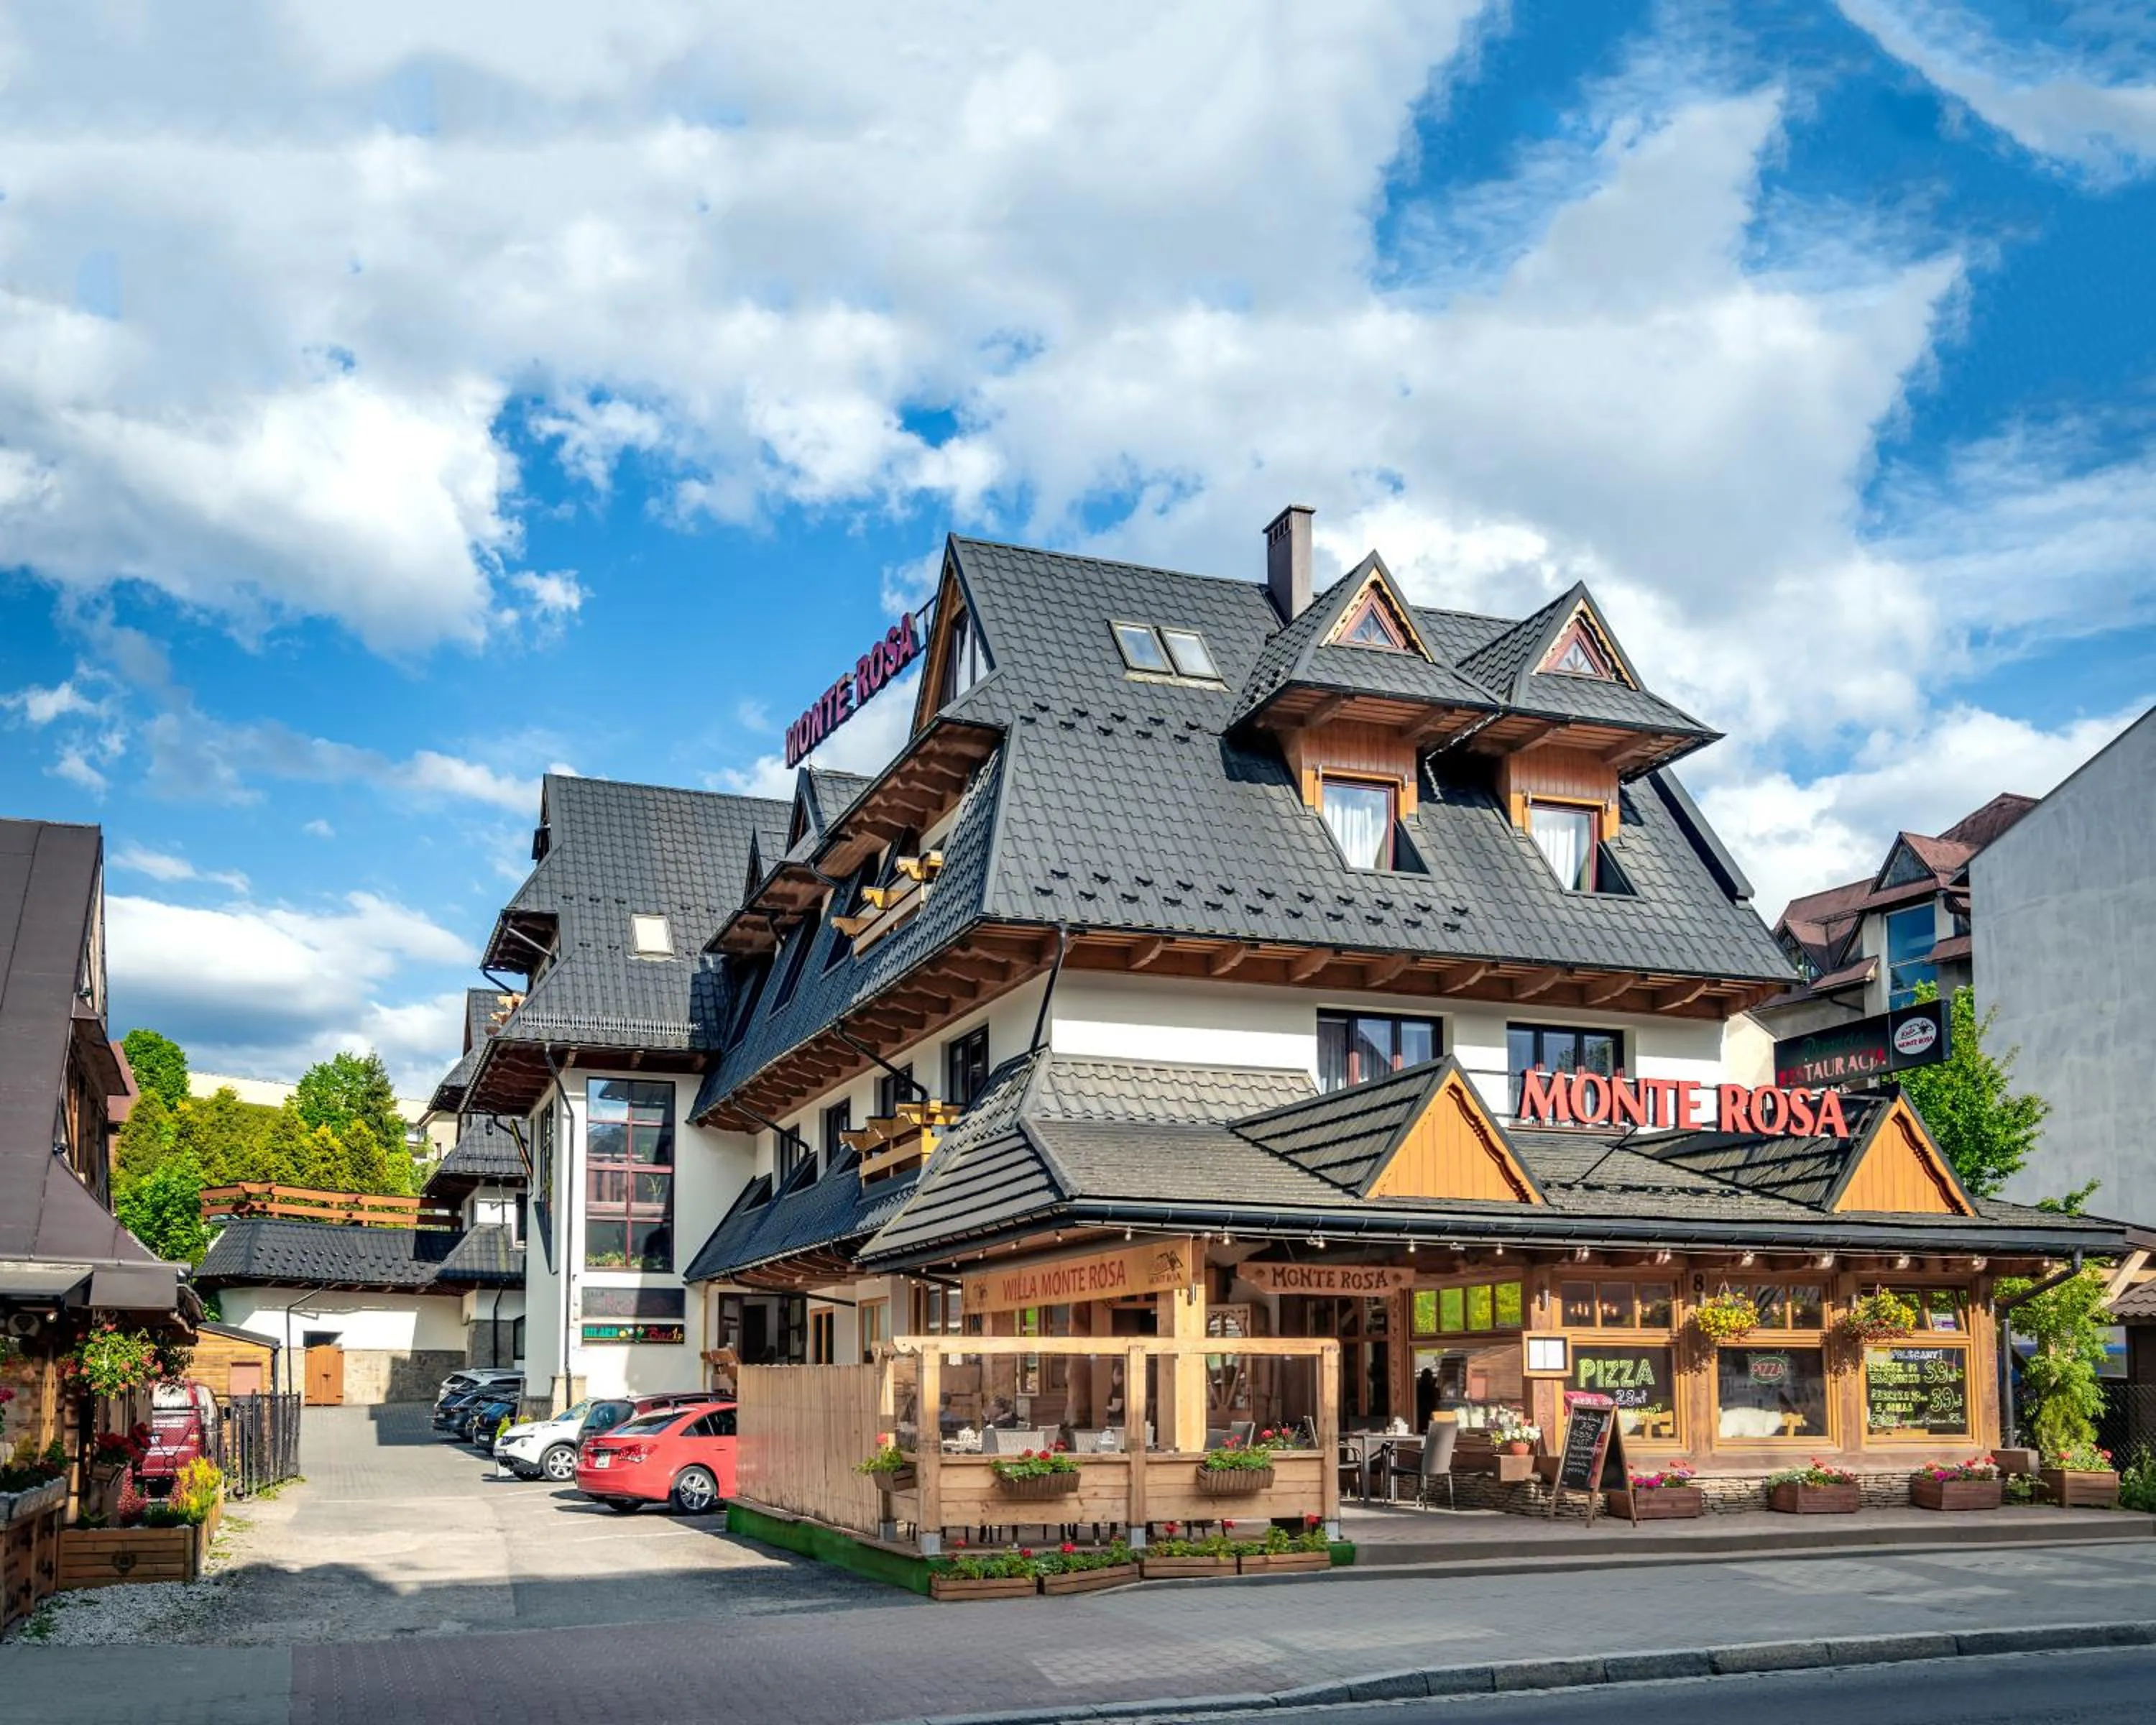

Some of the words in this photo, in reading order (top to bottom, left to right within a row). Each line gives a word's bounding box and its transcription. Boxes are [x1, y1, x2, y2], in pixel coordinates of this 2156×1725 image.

[786, 673, 852, 767] MONTE
[855, 612, 919, 704] ROSA
[1520, 1069, 1702, 1129] MONTE
[1717, 1084, 1850, 1138] ROSA
[1003, 1275, 1037, 1302] WILLA
[1041, 1266, 1086, 1297] MONTE
[1089, 1259, 1126, 1290] ROSA
[1271, 1268, 1335, 1289] MONTE
[1341, 1270, 1388, 1289] ROSA
[1693, 1274, 1704, 1292] 8
[1578, 1358, 1656, 1388] PIZZA
[1751, 1363, 1784, 1376] PIZZA
